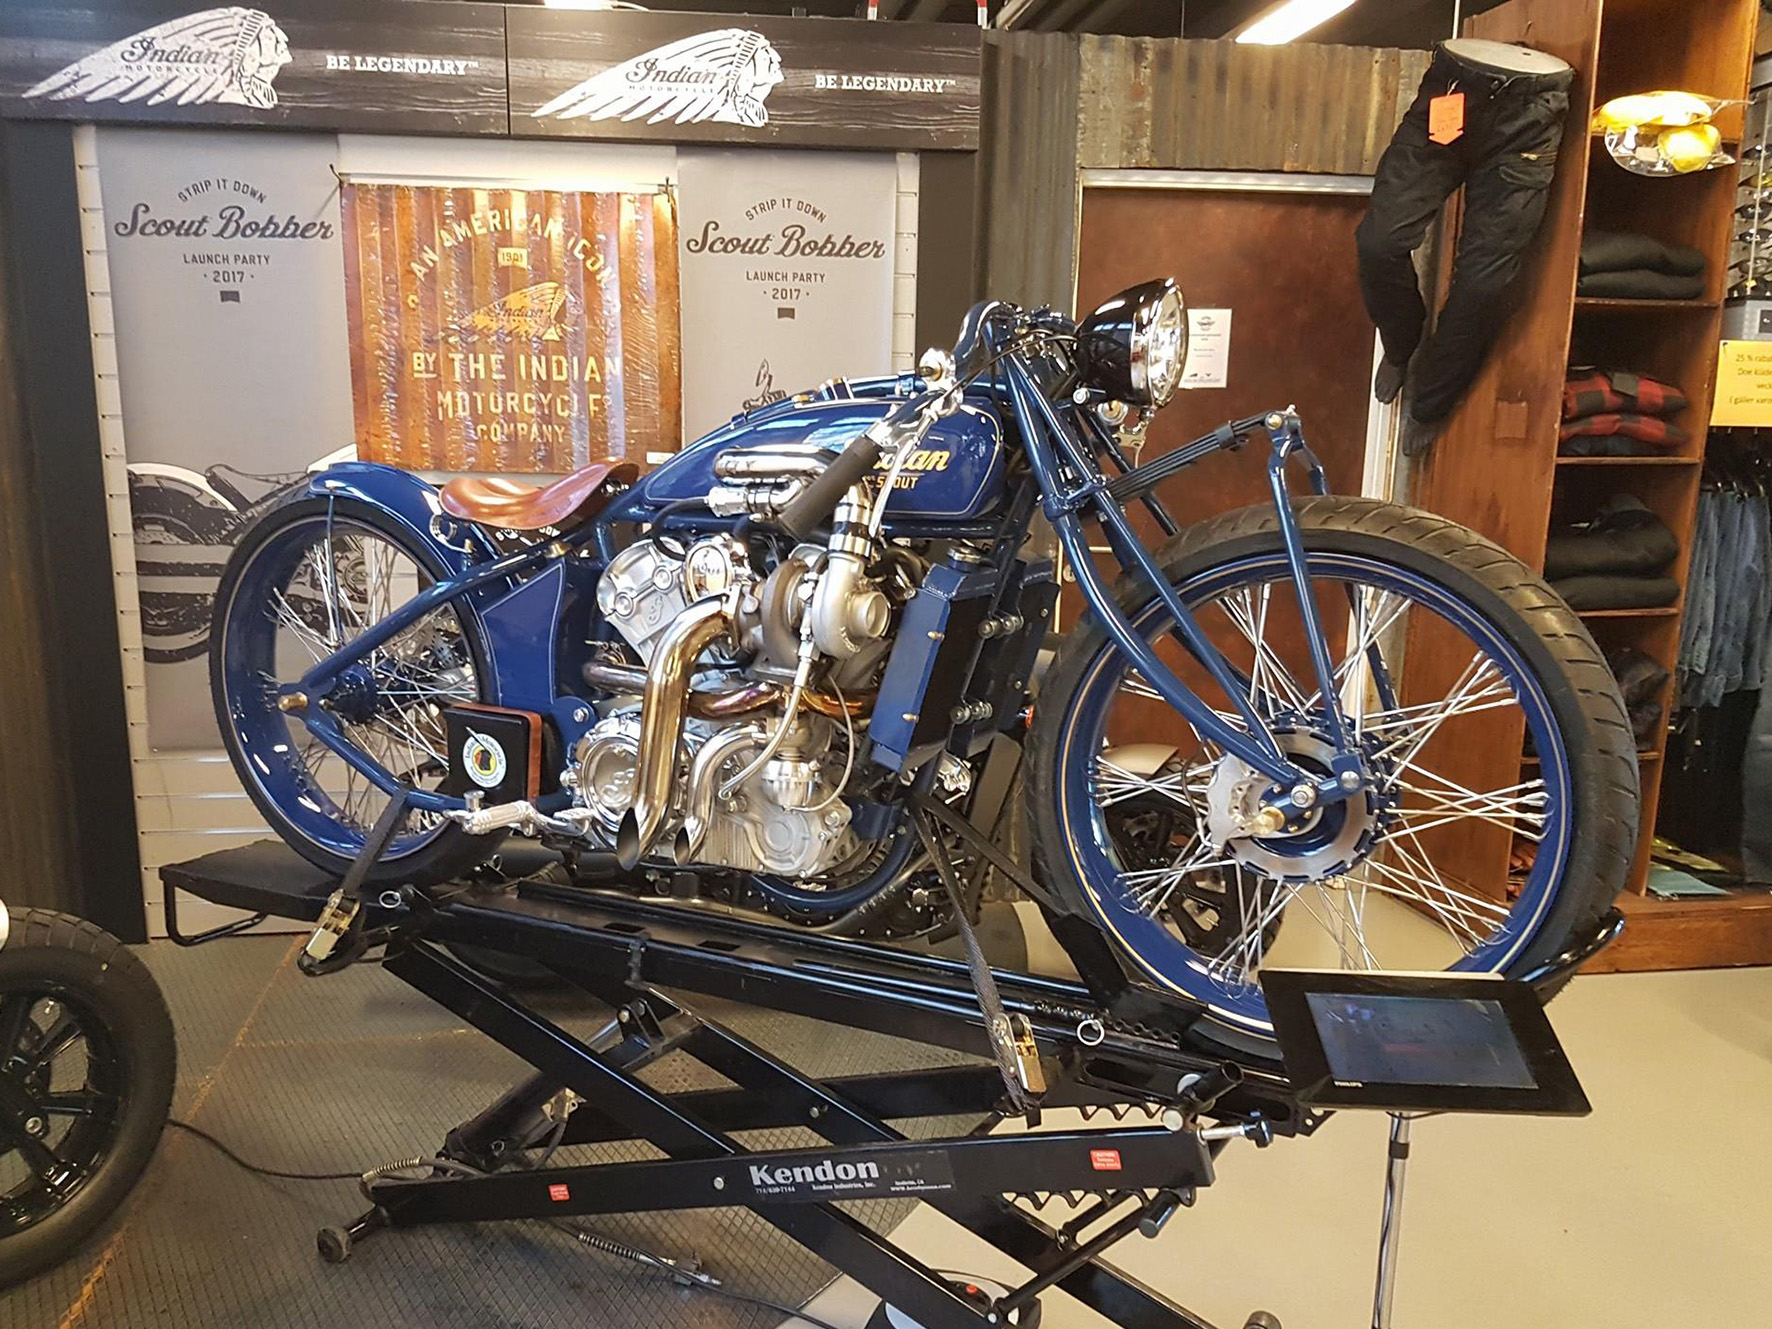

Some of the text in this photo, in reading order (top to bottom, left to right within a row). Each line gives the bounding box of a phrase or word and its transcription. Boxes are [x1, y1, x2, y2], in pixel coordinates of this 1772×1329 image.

[121, 36, 219, 65] Indian
[124, 65, 218, 74] MOTORCYCLE
[326, 55, 350, 70] BE
[625, 58, 717, 84] Indian
[815, 75, 837, 89] BE
[178, 178, 267, 204] STRIP IT DOWN
[114, 203, 334, 240] Scout Bobber
[745, 198, 827, 223] STRIP IT DOWN
[410, 245, 440, 282] AN
[438, 208, 564, 248] AMERICAN
[686, 220, 886, 259] Scout Bobber
[183, 253, 271, 266] LAUNCH PARTY
[501, 252, 523, 264] 1901
[213, 270, 245, 283] 2017
[746, 270, 825, 284] LAUNCH PARTY
[772, 288, 801, 300] 2017
[412, 352, 621, 382] BY THE INDIAN
[477, 422, 566, 444] COMPANY
[875, 476, 918, 489] SOUT
[749, 1160, 880, 1186] Kendon
